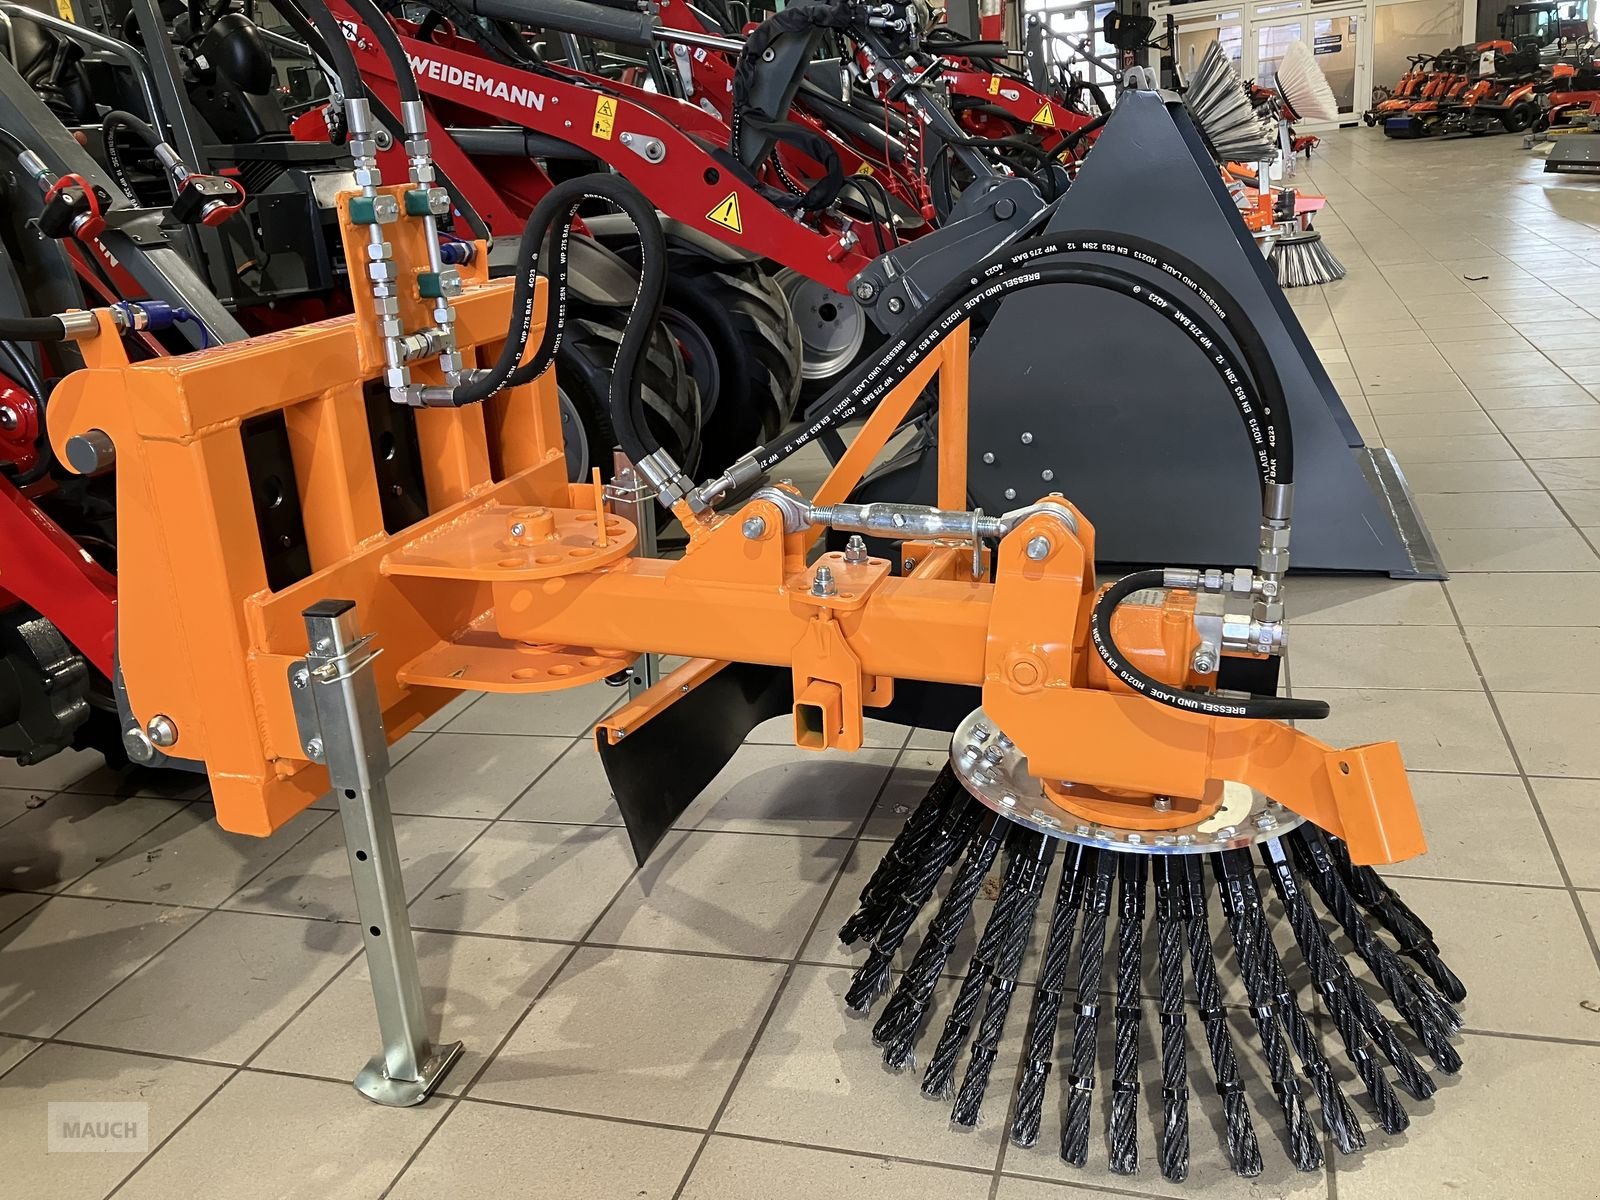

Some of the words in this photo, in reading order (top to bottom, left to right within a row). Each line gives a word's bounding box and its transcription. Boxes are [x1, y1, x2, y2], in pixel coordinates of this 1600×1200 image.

[406, 53, 545, 112] WEIDEMANN
[562, 224, 570, 239] BAR
[1029, 248, 1043, 258] 275
[1044, 244, 1058, 253] WP
[1067, 242, 1076, 250] 12
[1101, 243, 1116, 251] 853
[1116, 246, 1129, 255] EN
[560, 252, 567, 264] WP
[1011, 253, 1030, 263] BAR
[1134, 251, 1158, 265] HD213
[560, 273, 566, 281] 12
[1162, 262, 1182, 279] LADE
[1002, 272, 1040, 292] BRESSEL
[1182, 276, 1198, 290] UND
[985, 284, 1003, 297] UND
[964, 292, 985, 310] LADE
[1148, 293, 1168, 308] 4Q23
[1198, 287, 1226, 319] BRESSEL
[940, 309, 962, 329] HD213
[1174, 310, 1191, 326] BAR
[928, 330, 940, 341] EN
[1188, 323, 1203, 337] 275
[515, 352, 522, 360] 12
[520, 330, 529, 343] WP
[918, 339, 931, 351] 853
[1200, 336, 1213, 349] WP
[879, 340, 907, 367] BRESSEL
[906, 350, 920, 364] 2SN
[1215, 354, 1225, 365] 12
[868, 363, 883, 381] UND
[896, 365, 905, 373] 12
[1224, 367, 1238, 385] 2SN
[852, 379, 870, 396] LADE
[884, 376, 894, 388] WP
[873, 383, 885, 396] 275
[1234, 386, 1247, 401] 853
[832, 396, 852, 415] HD213
[861, 392, 875, 405] BAR
[1241, 401, 1252, 414] EN
[820, 415, 831, 425] EN
[809, 423, 822, 435] 853
[1248, 418, 1264, 444] HD213
[795, 432, 810, 445] 2SN
[1268, 426, 1276, 447] 4Q23
[784, 444, 793, 453] 12
[768, 453, 779, 464] WP
[1259, 449, 1270, 473] LADE
[1107, 657, 1118, 670] EN
[1120, 670, 1145, 691] HD210
[1150, 688, 1176, 704] LADE
[1177, 698, 1198, 709] UND
[1201, 701, 1247, 715] BRESSEL
